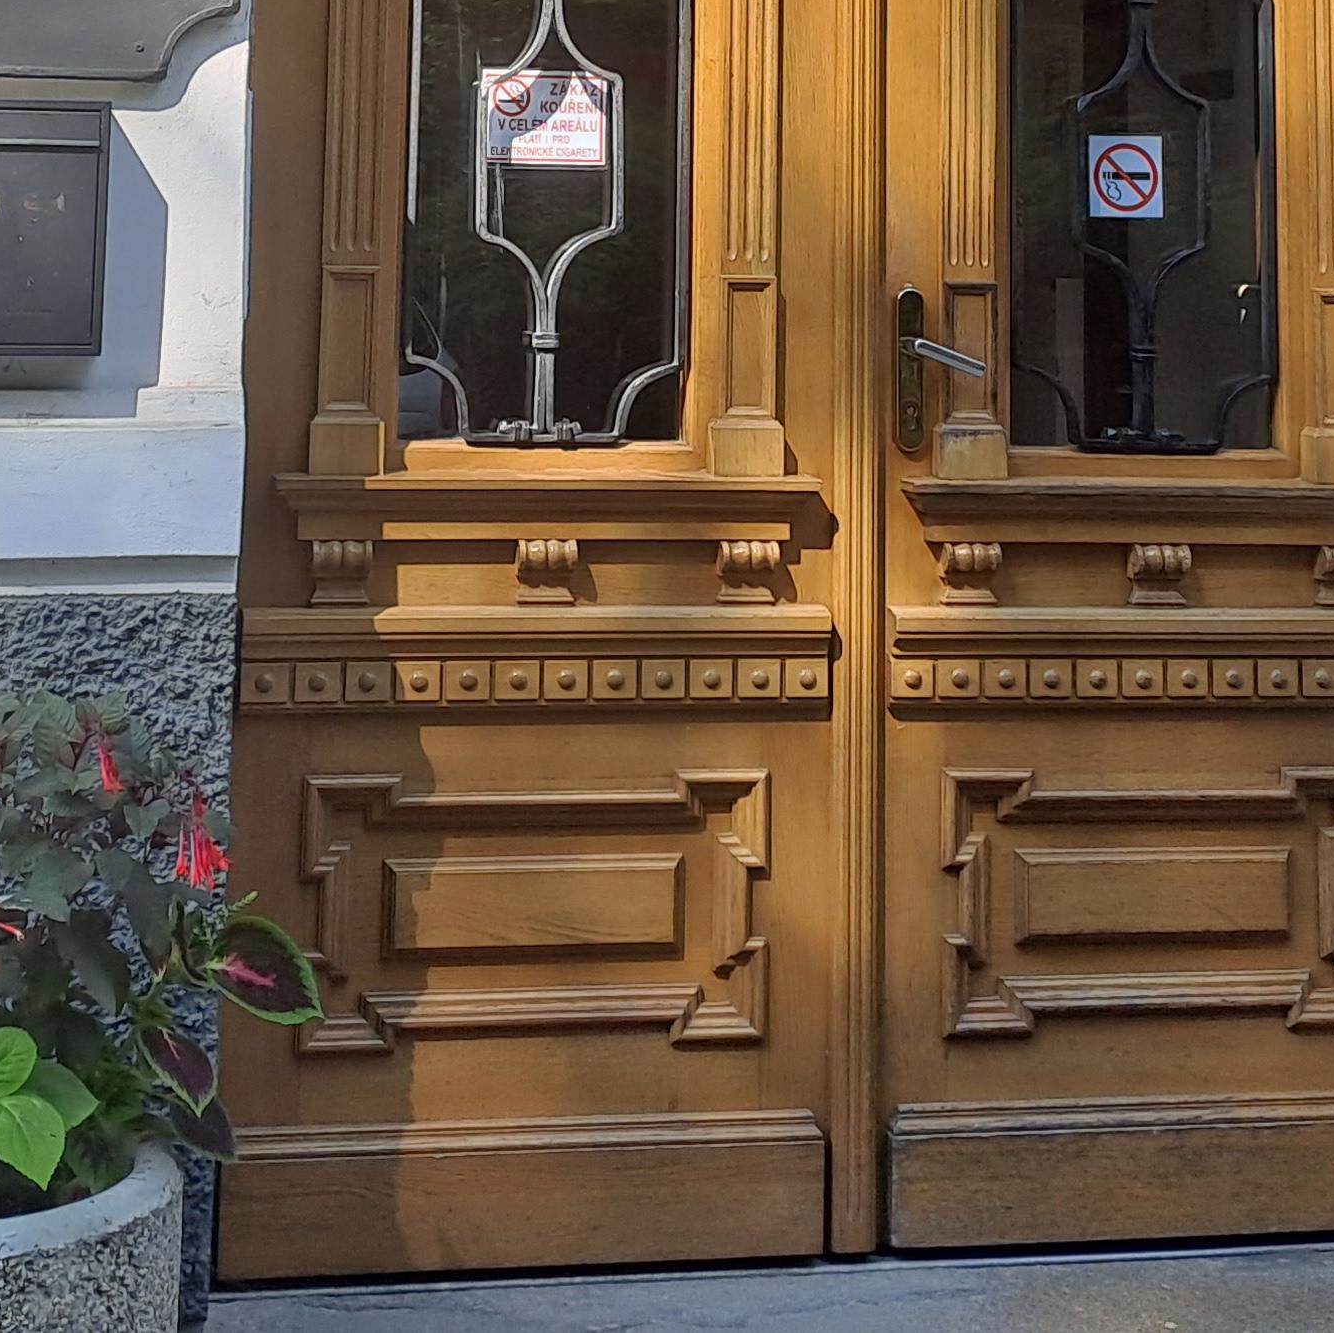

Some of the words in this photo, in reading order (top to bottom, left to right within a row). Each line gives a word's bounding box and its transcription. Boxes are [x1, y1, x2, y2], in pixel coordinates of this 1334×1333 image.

[550, 82, 598, 97] ZÁKAZ
[540, 100, 598, 114] KOUŘENÍ
[498, 118, 506, 131] V
[509, 117, 547, 131] CELÉM
[551, 117, 598, 132] AREÁLU
